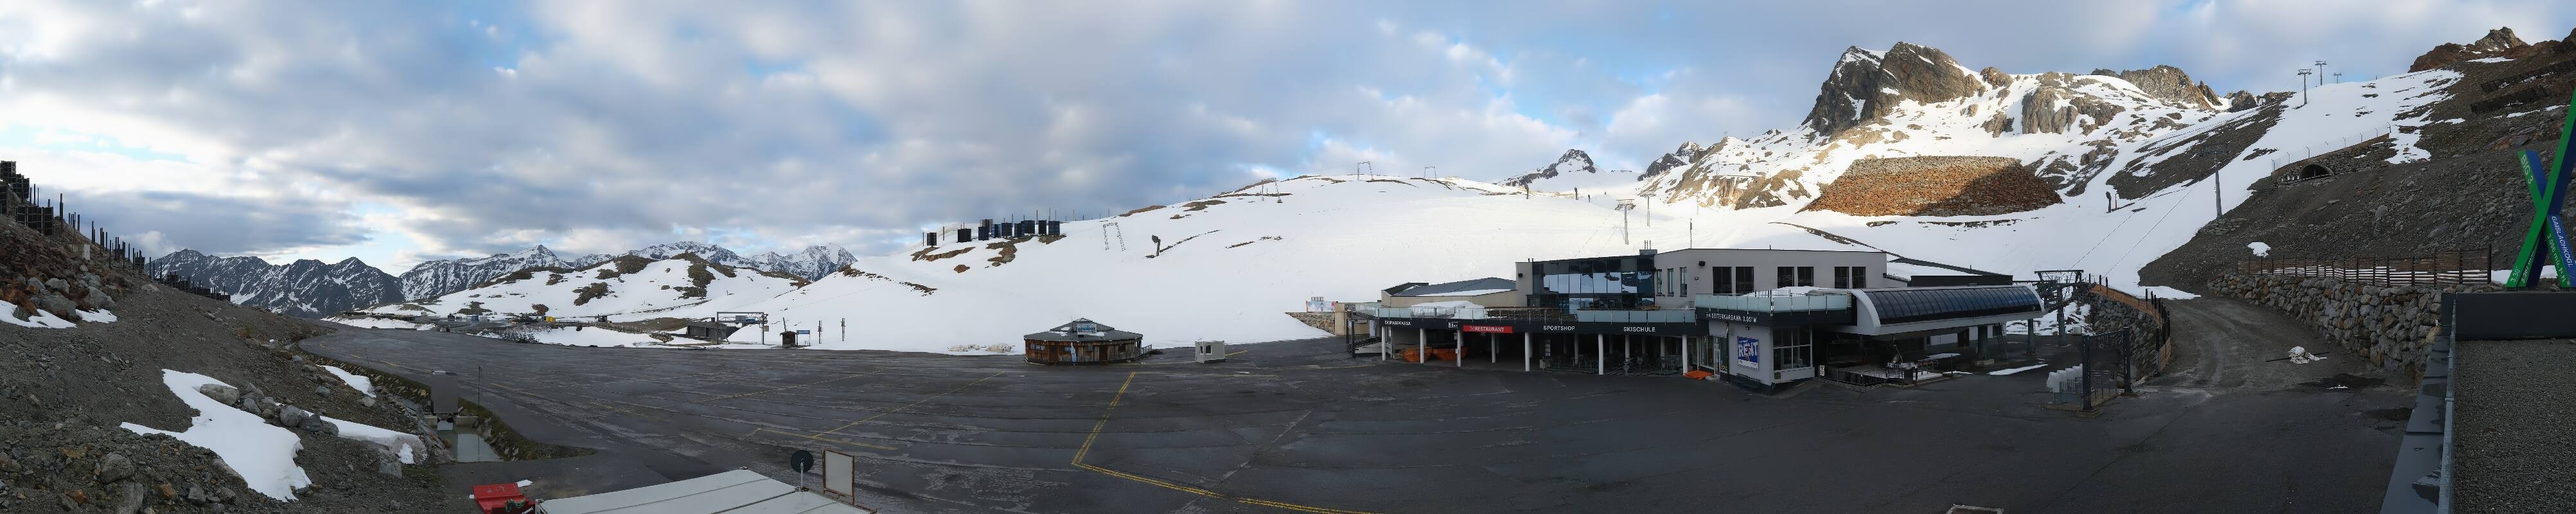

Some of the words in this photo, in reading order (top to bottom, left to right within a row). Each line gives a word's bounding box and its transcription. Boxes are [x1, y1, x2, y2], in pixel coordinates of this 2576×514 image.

[2521, 154, 2530, 175] BIG
[2528, 175, 2534, 184] 3
[2552, 216, 2573, 268] GAISLACHKOGL
[1738, 341, 1758, 357] RENT
